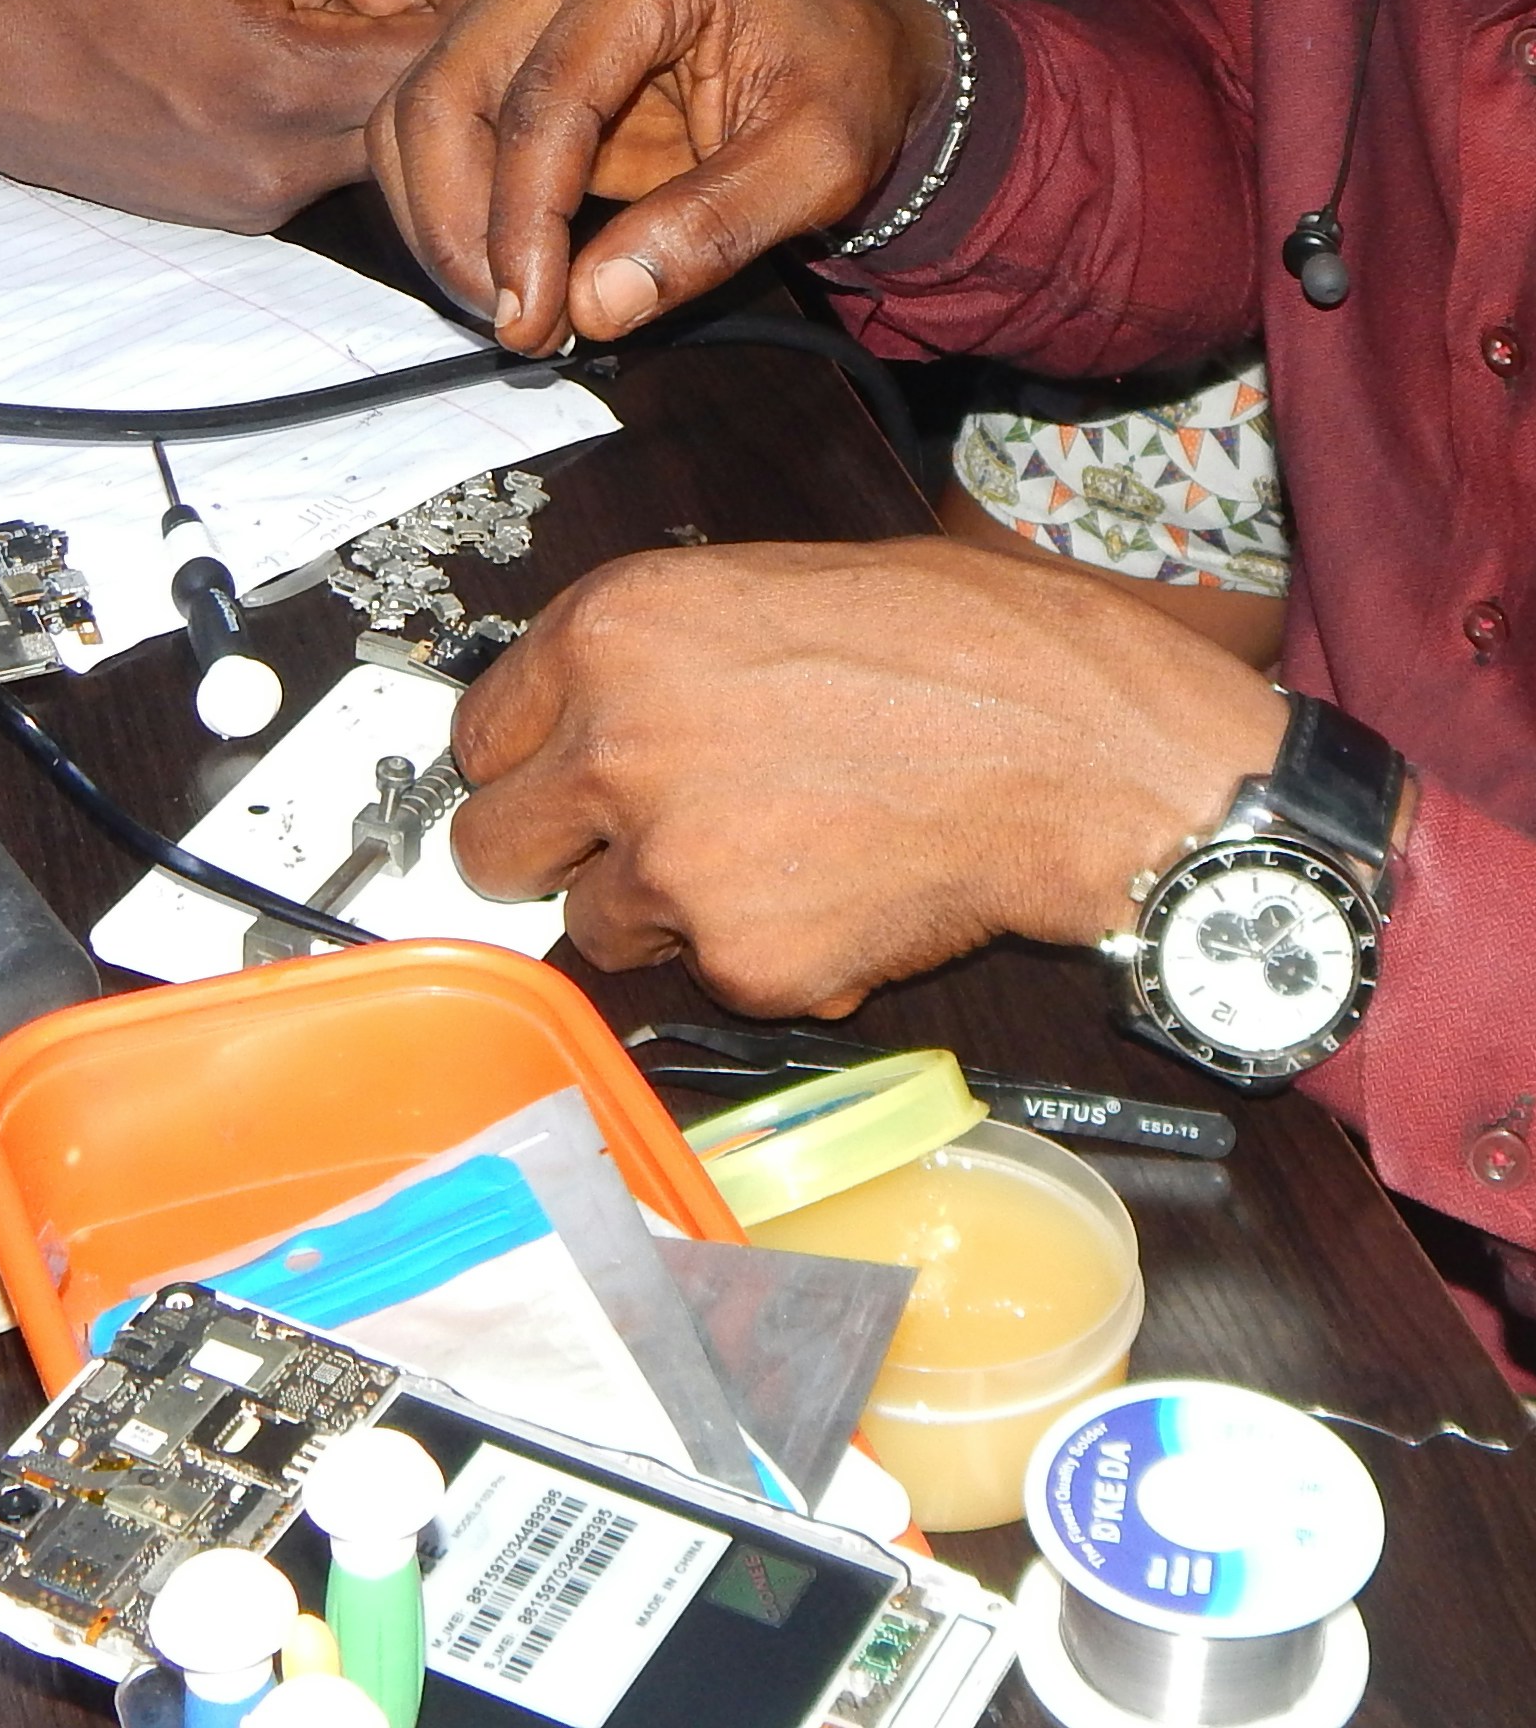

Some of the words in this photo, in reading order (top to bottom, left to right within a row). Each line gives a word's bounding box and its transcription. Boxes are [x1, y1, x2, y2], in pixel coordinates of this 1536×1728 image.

[1141, 1119, 1200, 1140] ESD-15
[1068, 1423, 1108, 1458] Solder
[1055, 1457, 1081, 1501] Quality
[1057, 1503, 1087, 1544] Finest
[1080, 1540, 1107, 1570] The
[635, 1592, 666, 1628] MADE
[662, 1576, 677, 1594] IN
[674, 1538, 706, 1575] CHINA
